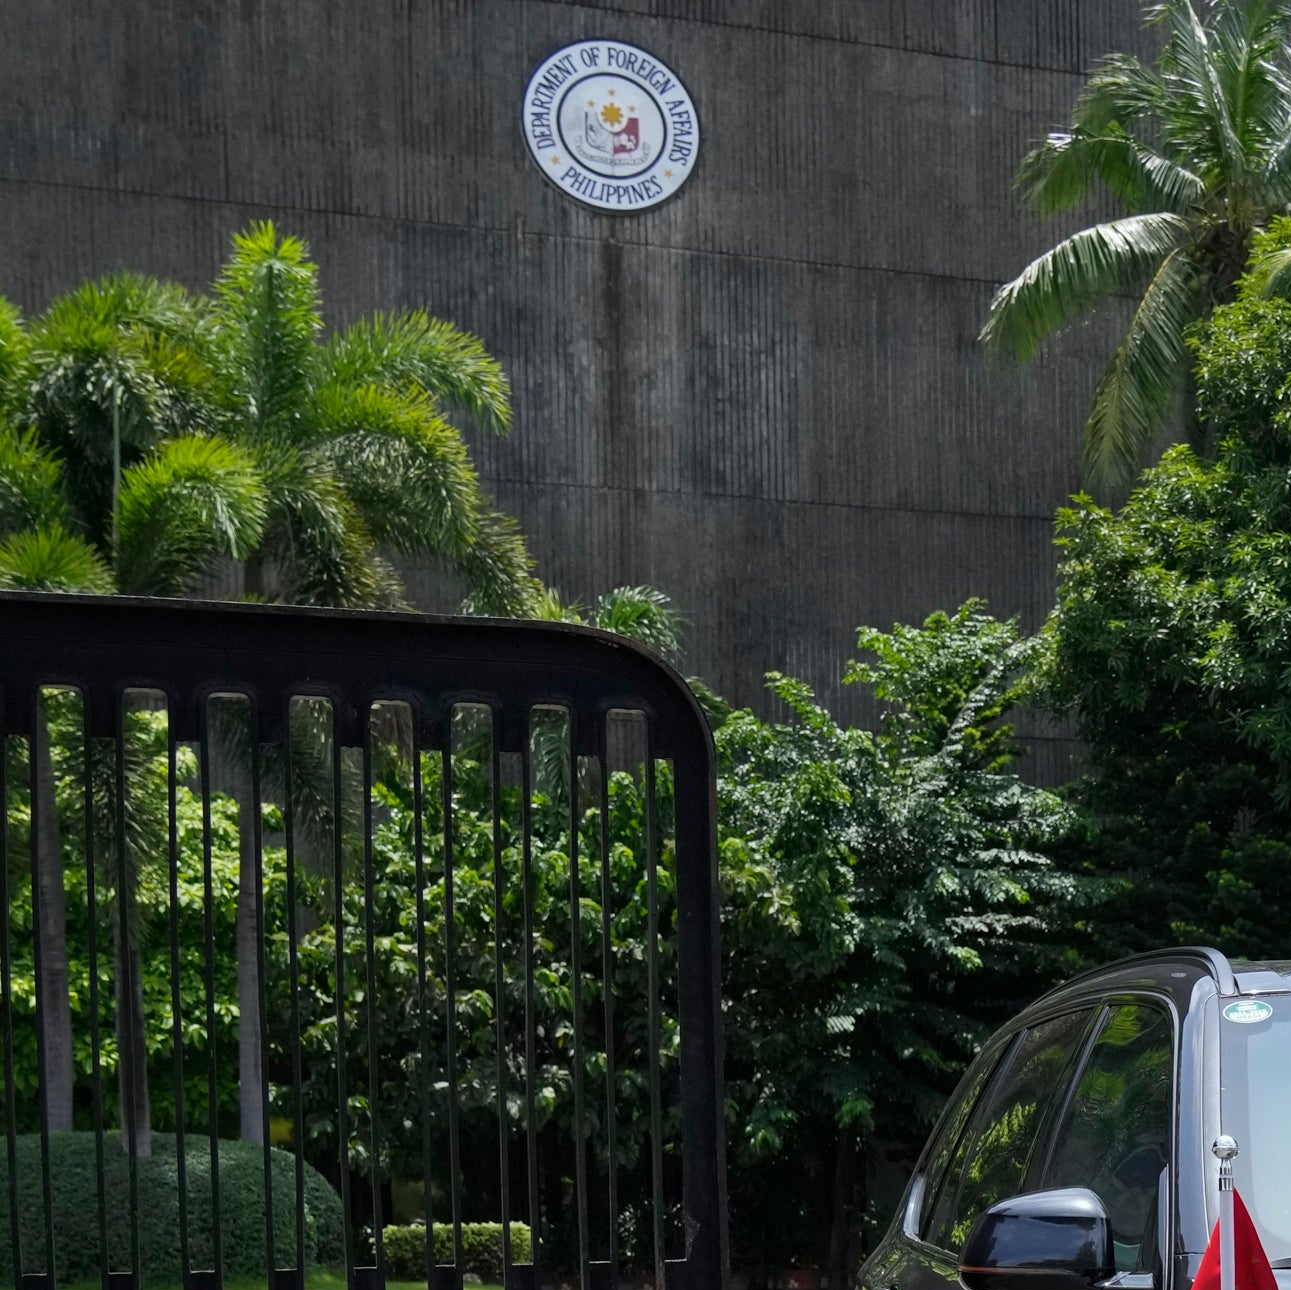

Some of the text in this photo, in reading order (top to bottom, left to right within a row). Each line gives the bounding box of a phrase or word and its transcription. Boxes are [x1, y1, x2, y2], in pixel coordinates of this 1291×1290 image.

[530, 54, 578, 150] DEPARTMENT
[580, 47, 600, 68] OF
[606, 47, 676, 96] FOREIGN
[665, 100, 692, 166] AFFAIRS
[560, 166, 663, 204] PHILIPPINES
